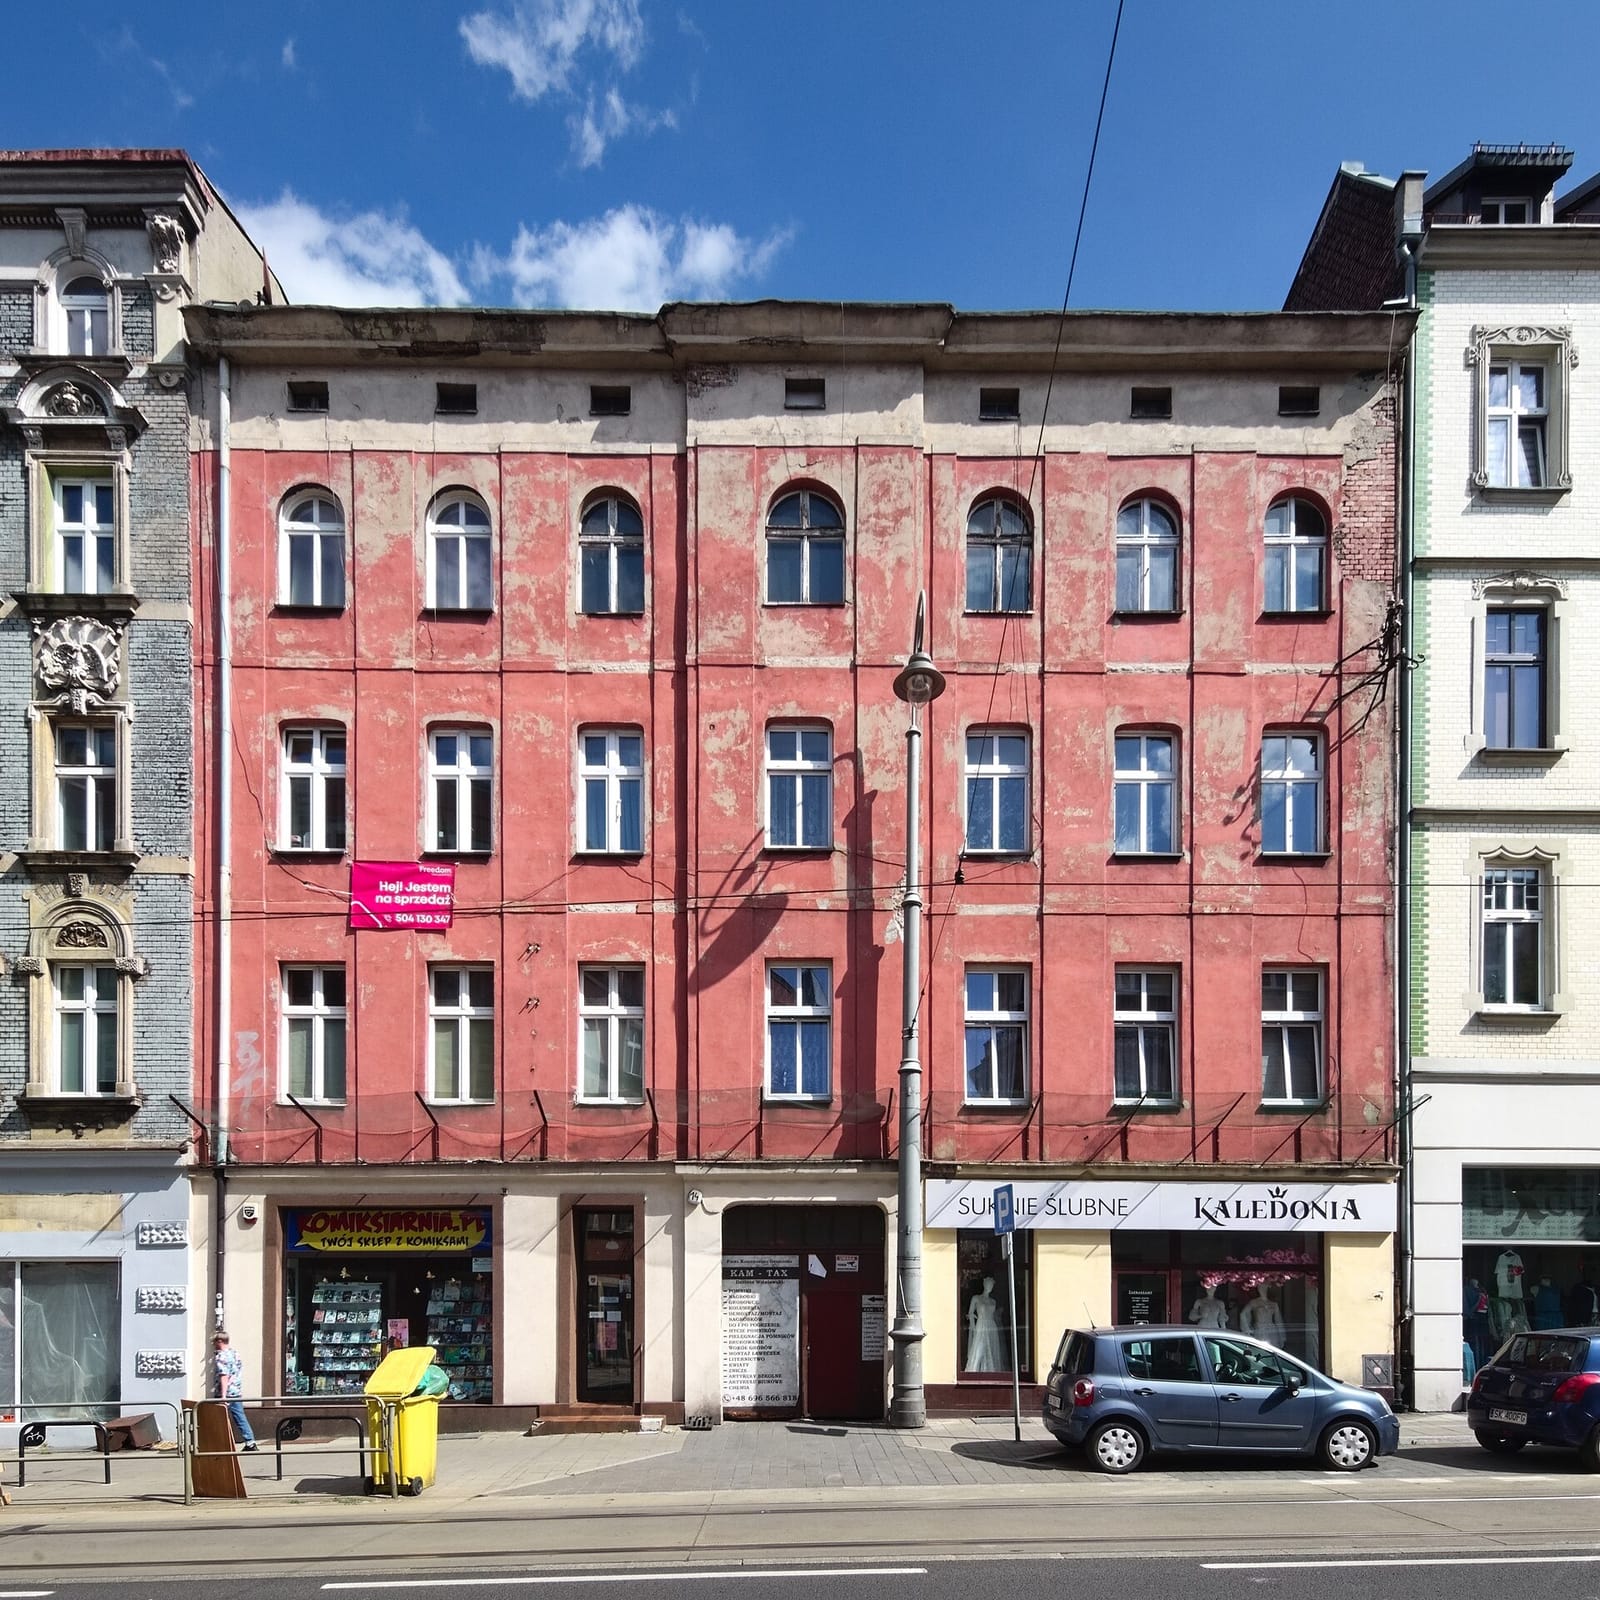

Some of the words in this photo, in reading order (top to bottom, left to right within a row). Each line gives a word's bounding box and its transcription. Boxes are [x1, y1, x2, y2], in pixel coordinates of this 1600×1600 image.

[418, 866, 452, 874] Freedom
[379, 881, 402, 893] Hej!
[404, 882, 451, 893] Jestem
[375, 895, 392, 904] na
[394, 894, 451, 906] sprzedaż
[395, 914, 414, 922] 504
[416, 914, 433, 924] 130
[434, 914, 450, 924] 347
[998, 1191, 1009, 1228] P
[1044, 1193, 1128, 1216] ŚLUBNE
[1194, 1197, 1362, 1226] KALEDONIA
[297, 1210, 486, 1233] KOMIKSIARNIA.PL
[320, 1234, 352, 1247] TWÓJ
[357, 1236, 392, 1247] SKLEP
[396, 1237, 402, 1247] Z
[406, 1236, 469, 1247] KOMIKSAMI
[730, 1269, 754, 1277] KAM
[766, 1269, 788, 1277] TAX
[732, 1394, 746, 1402] +48
